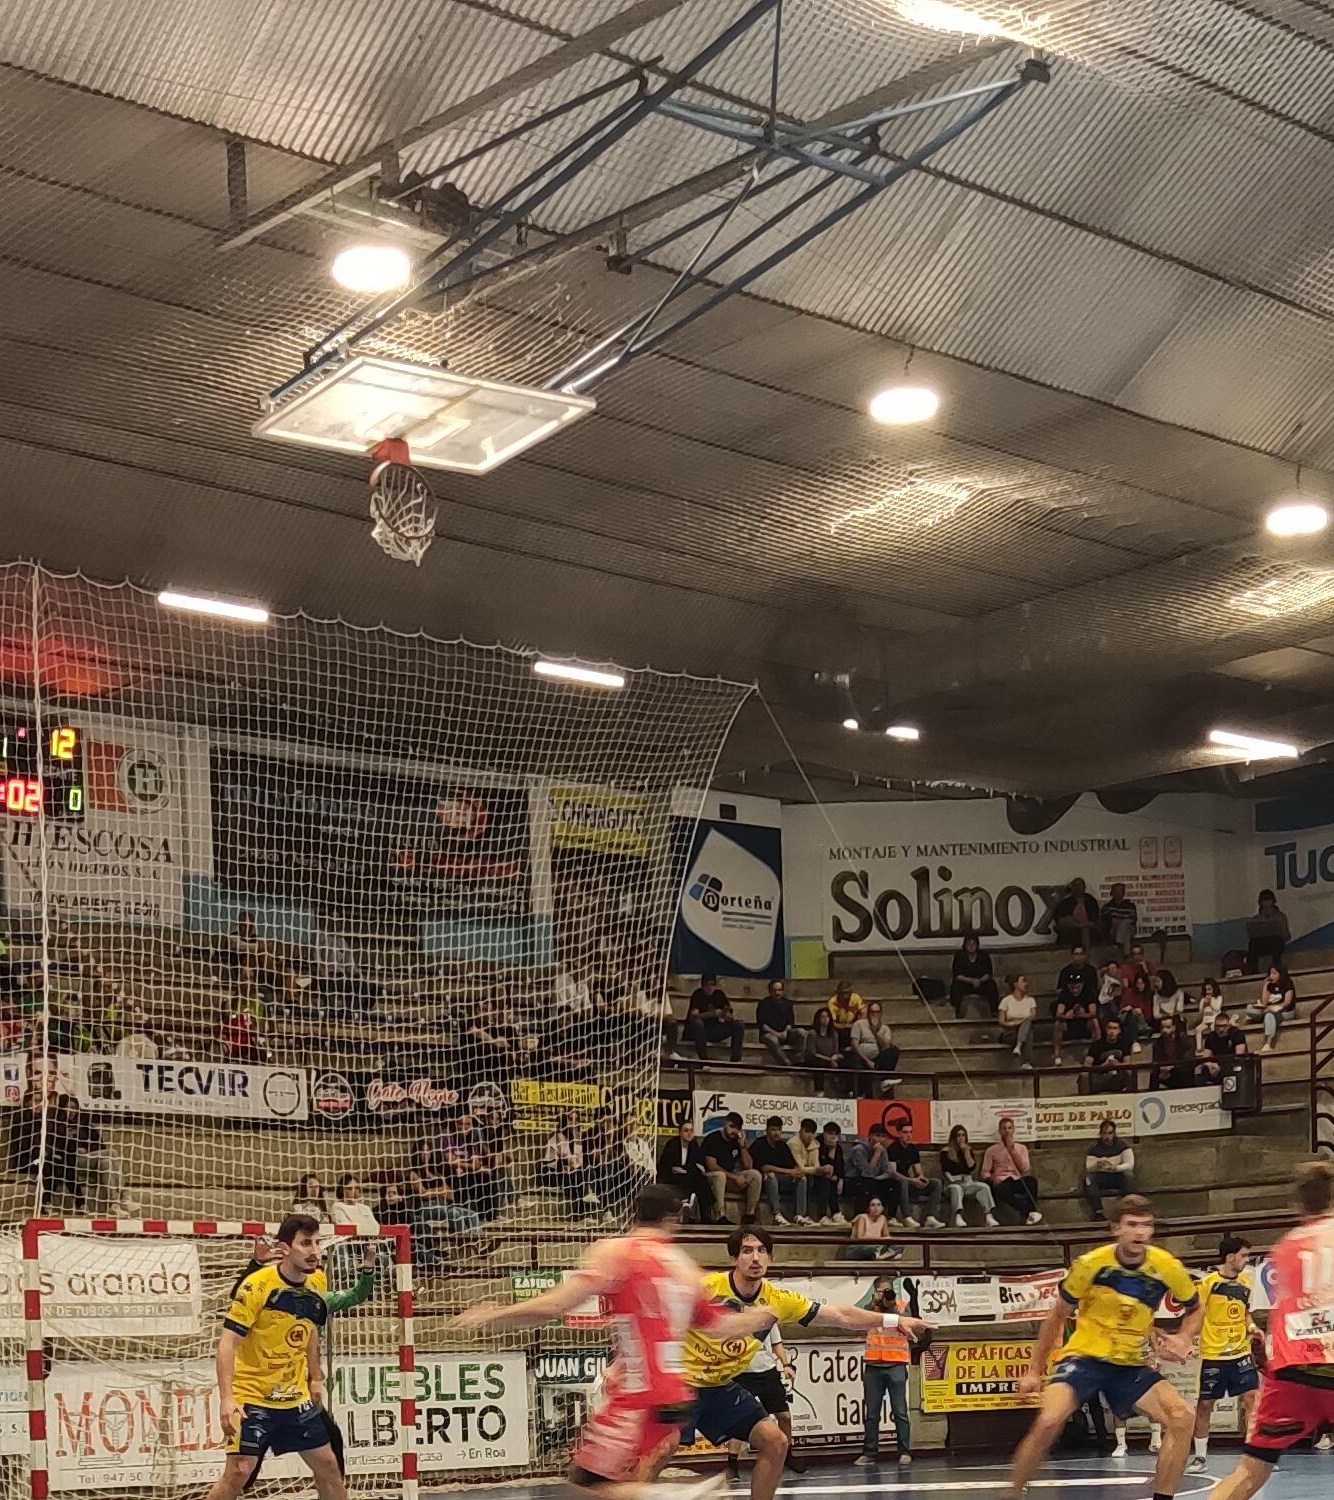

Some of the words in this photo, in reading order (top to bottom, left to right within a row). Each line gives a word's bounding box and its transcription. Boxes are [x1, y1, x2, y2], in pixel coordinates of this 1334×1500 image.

[51, 728, 76, 759] 12
[828, 846, 897, 860] MONTAJE
[901, 846, 910, 857] Y
[917, 841, 1040, 858] MANTENIMIENTO
[1044, 838, 1131, 853] INDUSTRIAL
[137, 1063, 250, 1098] TECVIR
[749, 1098, 798, 1111] ASESORÍA
[803, 1101, 851, 1114] GESTORÍA
[1035, 1111, 1064, 1123] LUIS
[1068, 1110, 1083, 1122] DE
[68, 1262, 191, 1297] aranda
[955, 1343, 1032, 1361] GRÁFICAS
[536, 1356, 579, 1379] JUAN
[956, 1365, 976, 1380] DE
[981, 1365, 1000, 1379] LA
[469, 1448, 483, 1460] En
[485, 1447, 506, 1459] Roa
[103, 1473, 125, 1483] 947
